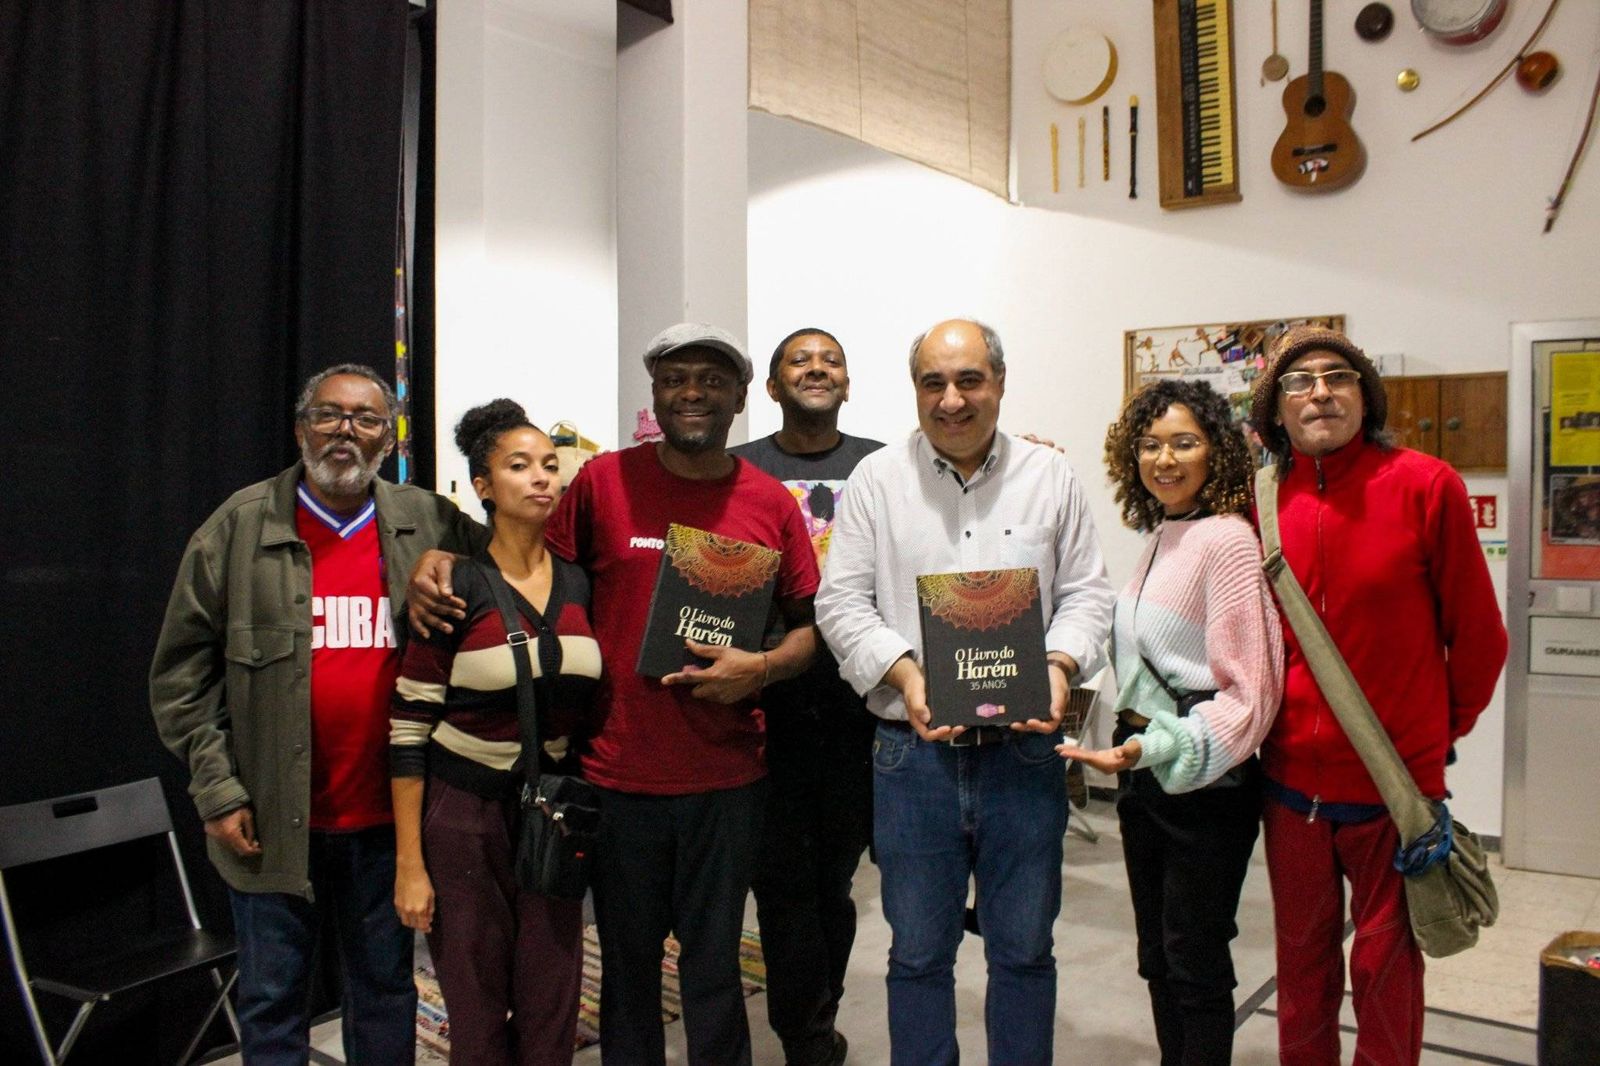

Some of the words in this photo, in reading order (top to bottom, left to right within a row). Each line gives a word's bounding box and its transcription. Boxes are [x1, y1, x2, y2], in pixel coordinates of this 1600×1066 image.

[629, 536, 665, 550] PONTO
[680, 605, 691, 619] O
[690, 608, 721, 626] Livro
[720, 616, 735, 630] do
[674, 618, 733, 648] Harém
[955, 648, 966, 662] O
[967, 647, 999, 661] Livro
[1000, 645, 1015, 659] do
[957, 659, 1019, 680] Harém
[969, 681, 980, 691] 35
[982, 679, 1007, 689] ANOS
